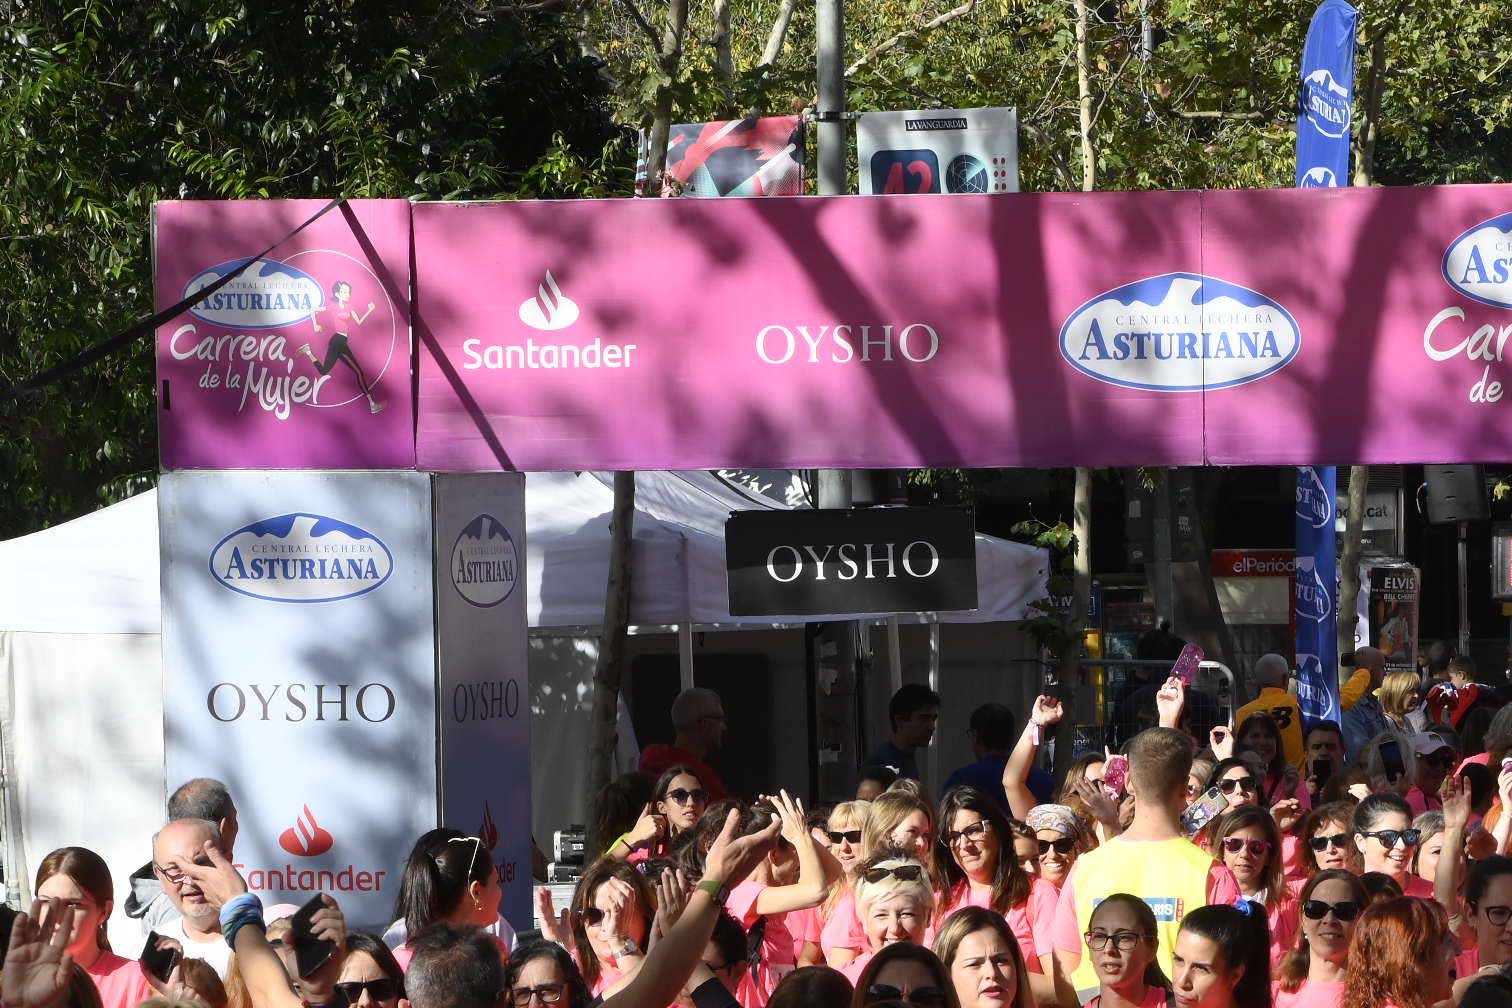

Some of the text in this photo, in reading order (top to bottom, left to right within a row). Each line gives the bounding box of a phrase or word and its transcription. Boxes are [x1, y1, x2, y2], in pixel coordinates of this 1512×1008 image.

[1115, 314, 1192, 326] CENTRAL
[169, 324, 288, 362] Carrera
[463, 338, 636, 370] Santander
[755, 323, 940, 364] OYSHO
[1079, 318, 1282, 361] ASTURIANA
[199, 359, 332, 420] de la Mujer
[1469, 366, 1504, 404] de
[224, 546, 381, 580] ASTURIANA
[251, 544, 374, 553] CENTRAL LECHERA
[456, 551, 514, 584] ASTURIANA
[766, 541, 940, 582] OYSHO
[1384, 576, 1415, 589] ELVIS
[207, 682, 396, 723] OYSHO
[453, 678, 519, 724] OYSHO
